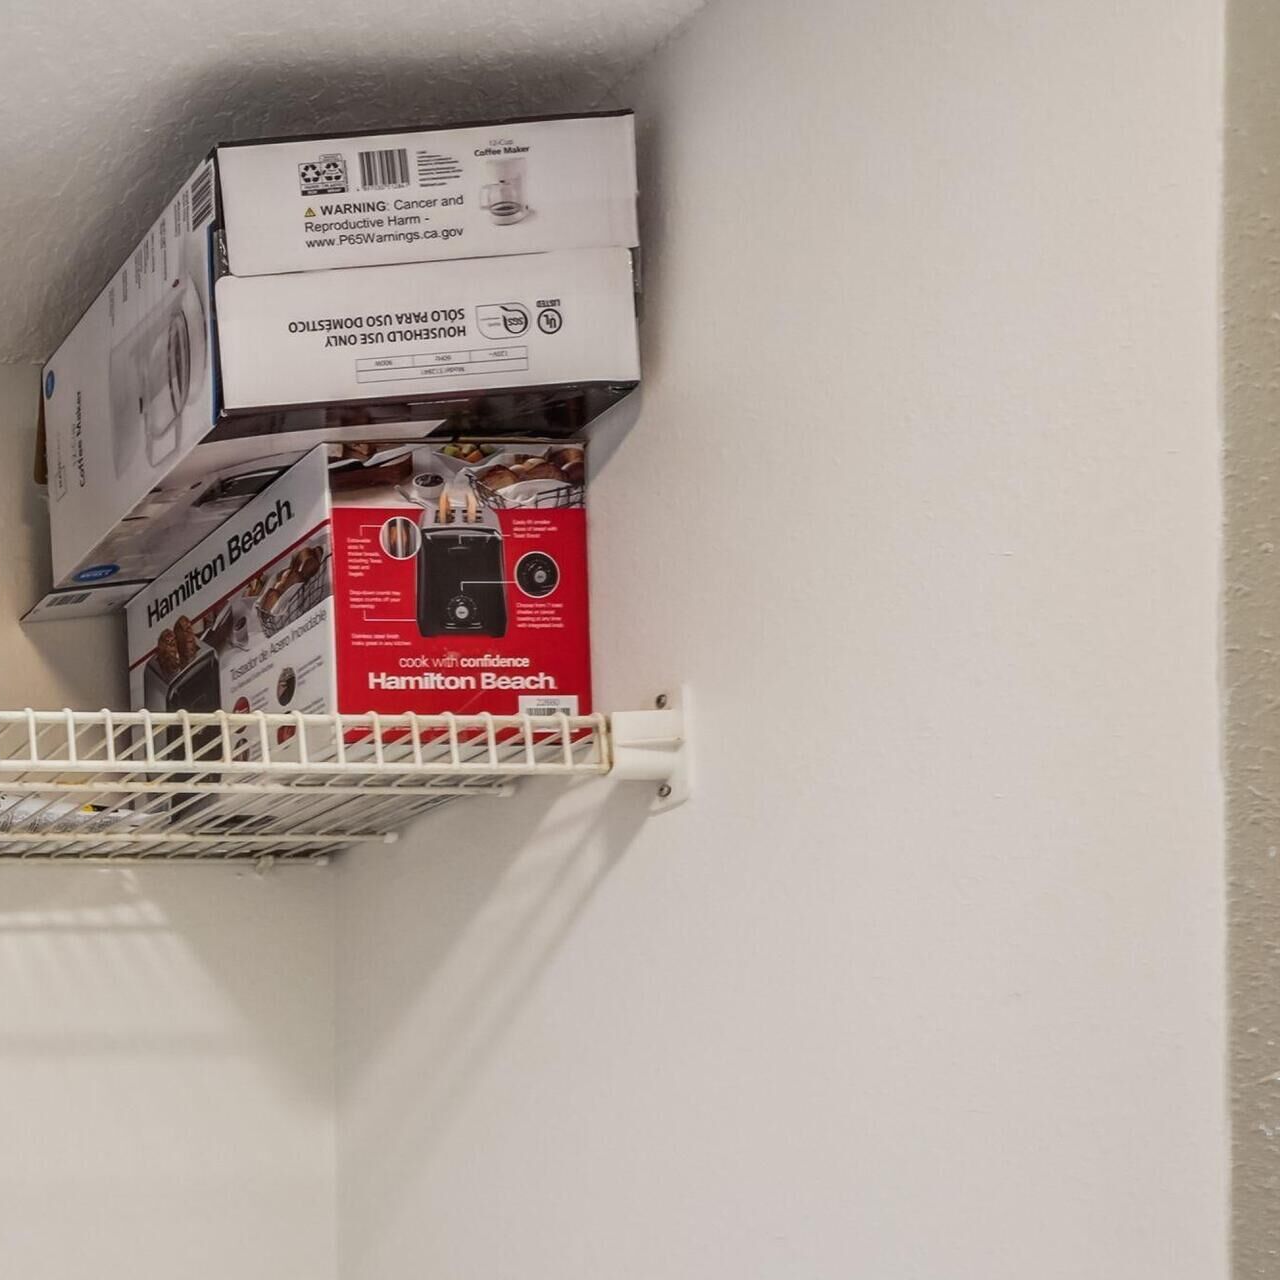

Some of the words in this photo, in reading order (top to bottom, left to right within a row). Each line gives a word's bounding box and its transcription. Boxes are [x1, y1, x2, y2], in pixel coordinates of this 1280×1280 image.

[474, 147, 502, 157] Coffee
[503, 144, 530, 155] Maker
[320, 201, 390, 216] WARNING:
[393, 197, 438, 211] Cancer
[441, 195, 464, 206] and
[304, 217, 384, 233] Reproductive
[387, 214, 421, 225] Harm
[305, 226, 464, 248] www.P65Warnings.ca.gov
[366, 314, 393, 328] USO
[396, 311, 428, 324] PARA
[431, 308, 465, 323] SÓLO
[288, 316, 363, 333] DOMÉSTICO
[324, 334, 357, 347] ONLY
[360, 331, 384, 344] USE
[388, 325, 467, 342] HOUSEHOLD
[147, 554, 226, 629] Hamilton
[226, 499, 293, 566] Beach
[399, 654, 430, 668] cook
[432, 653, 460, 668] with
[460, 653, 530, 669] confidence
[368, 672, 475, 691] Hamilton
[480, 672, 557, 691] Beach
